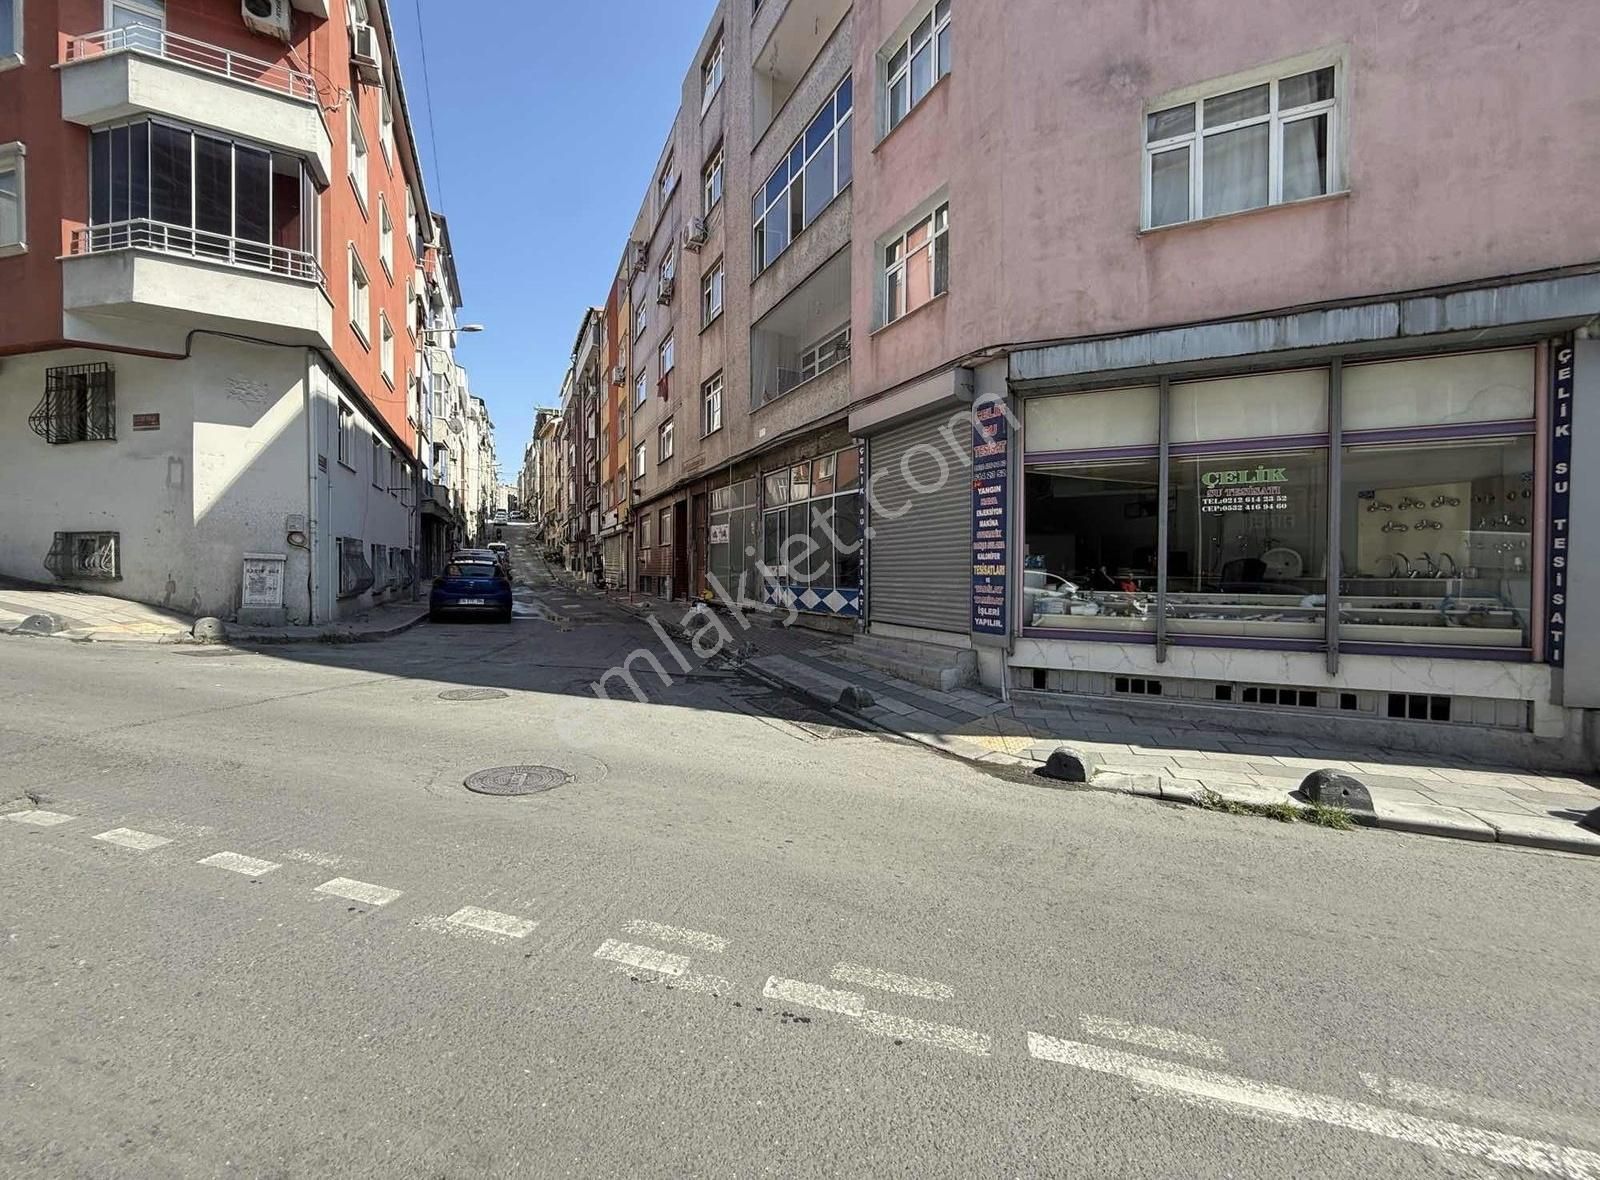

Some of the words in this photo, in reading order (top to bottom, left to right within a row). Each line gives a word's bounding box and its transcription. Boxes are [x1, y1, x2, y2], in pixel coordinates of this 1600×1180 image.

[1554, 349, 1572, 437] ÇELİK
[1201, 465, 1289, 488] ÇELİK
[1554, 463, 1569, 493] SU
[1206, 488, 1224, 498] SU
[1550, 519, 1567, 661] TESİSATI
